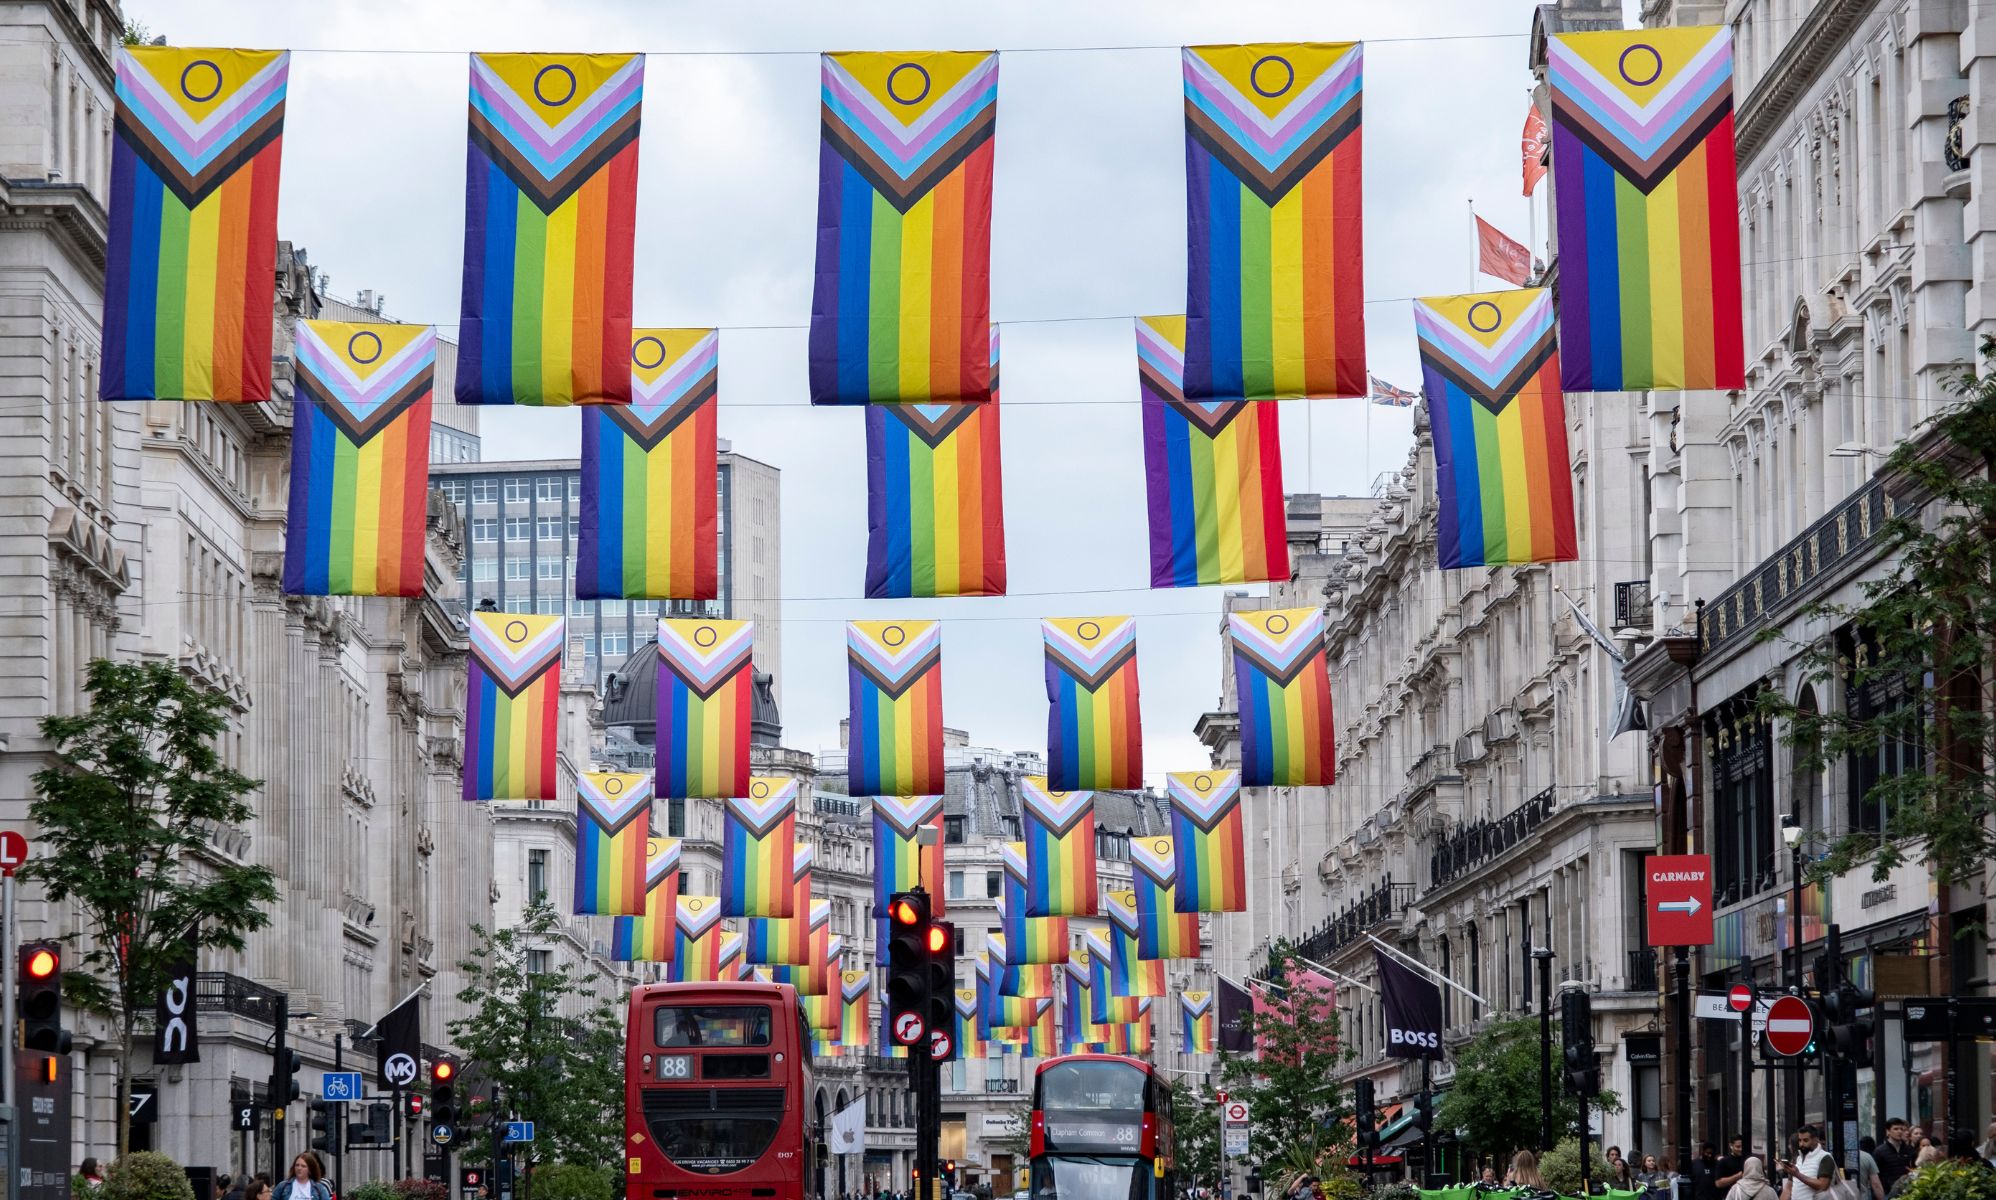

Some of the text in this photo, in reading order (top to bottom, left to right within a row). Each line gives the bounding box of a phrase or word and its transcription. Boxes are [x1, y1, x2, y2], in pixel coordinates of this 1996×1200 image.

[0, 836, 18, 864] L
[1652, 871, 1705, 882] CARNABY
[1712, 1003, 1728, 1012] BEA
[1391, 1028, 1438, 1048] BOSS
[388, 1062, 413, 1077] MK
[663, 1057, 687, 1077] 88
[1218, 1092, 1226, 1102] T
[1051, 1128, 1105, 1139] Clapham Common
[1116, 1127, 1134, 1141] 88
